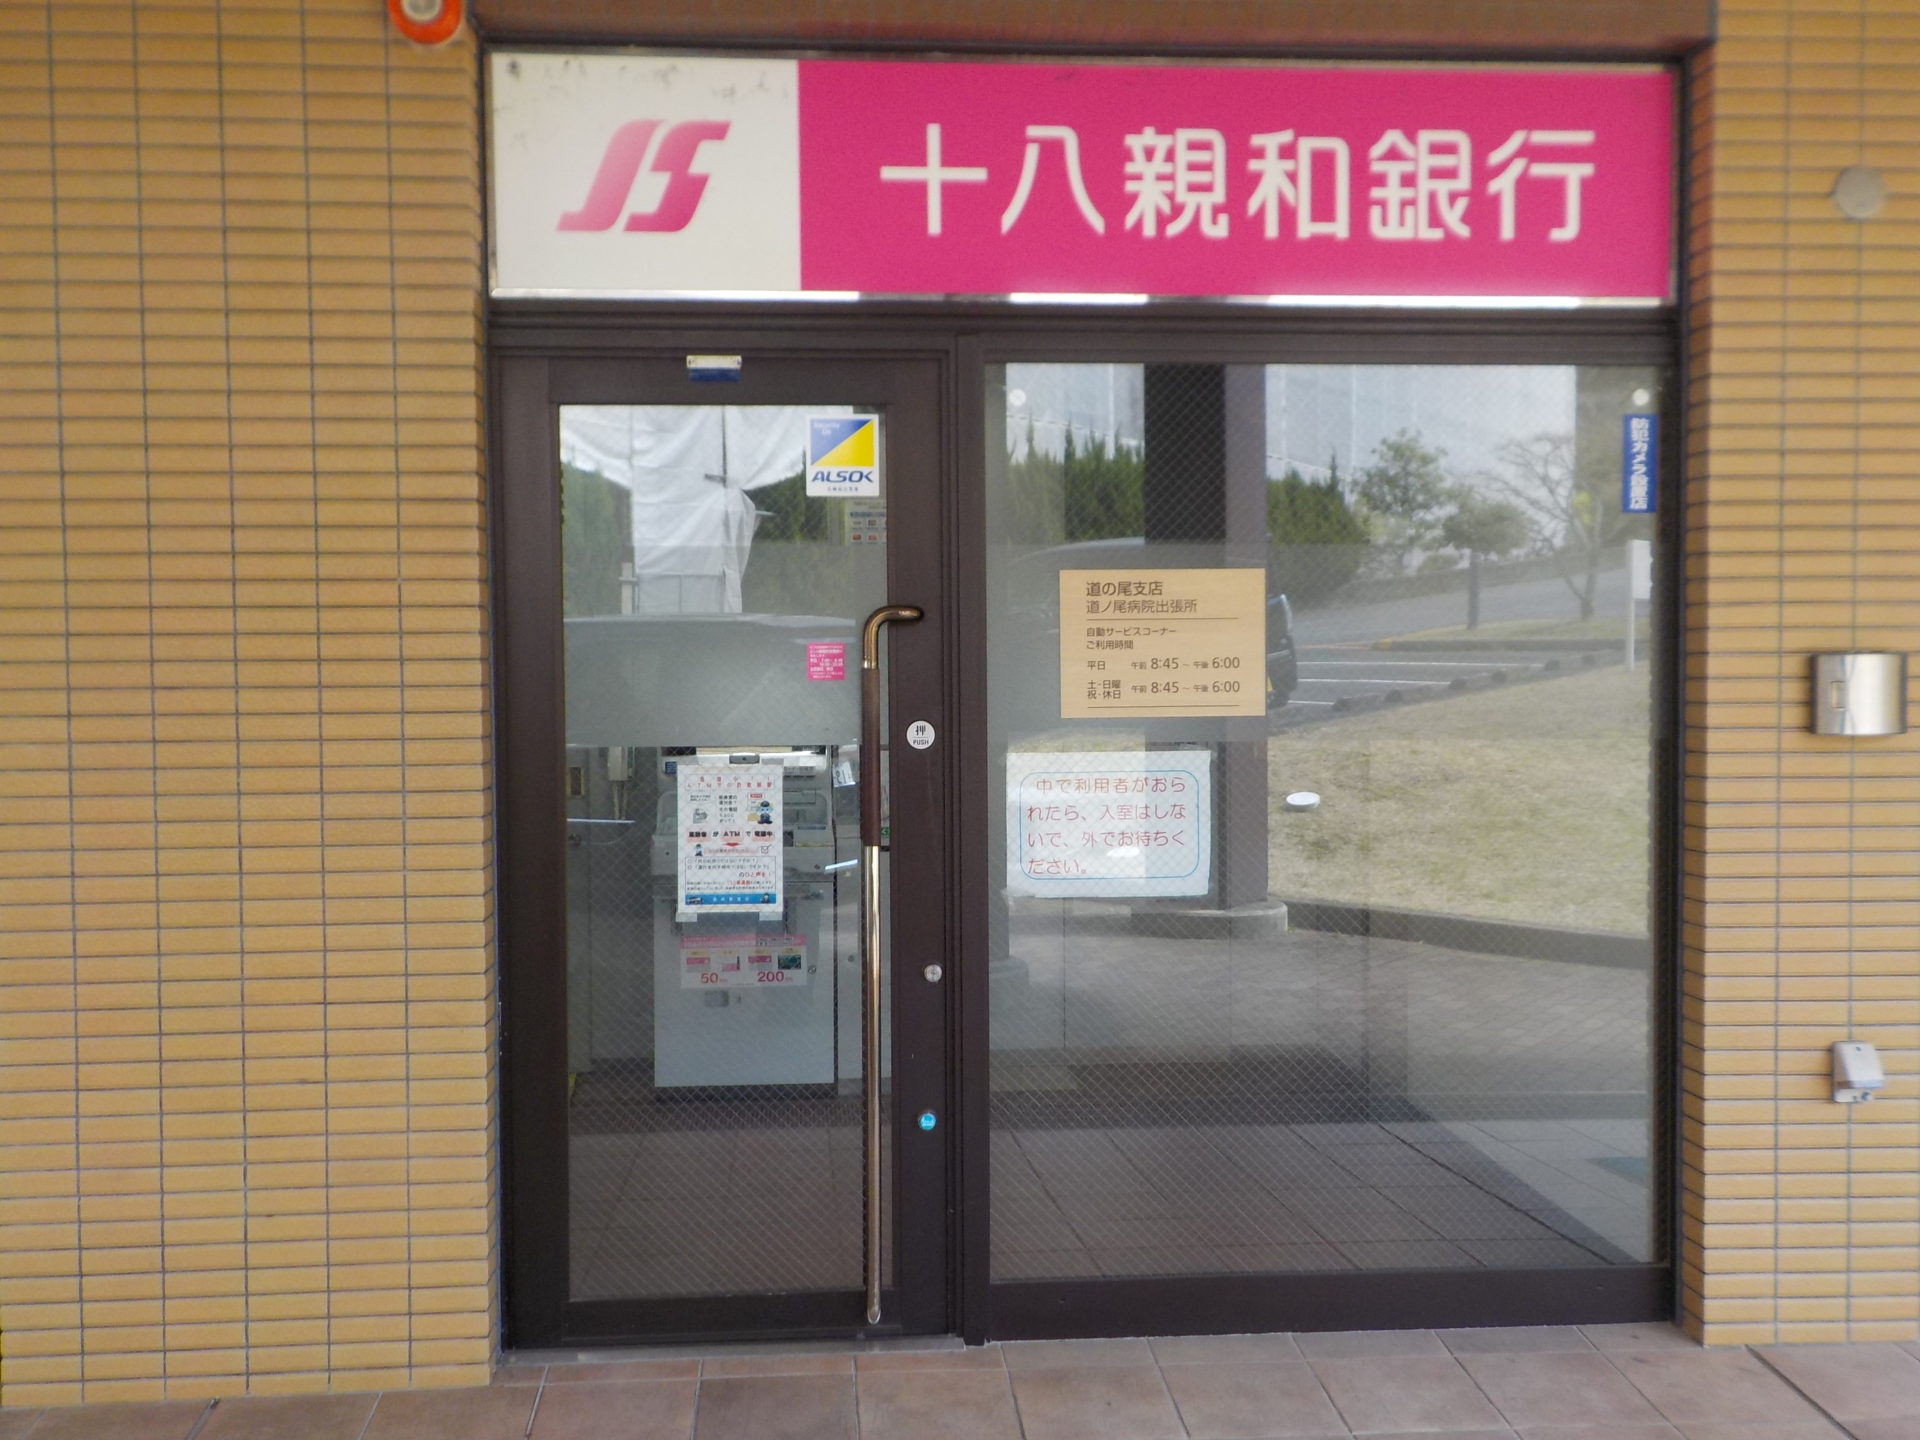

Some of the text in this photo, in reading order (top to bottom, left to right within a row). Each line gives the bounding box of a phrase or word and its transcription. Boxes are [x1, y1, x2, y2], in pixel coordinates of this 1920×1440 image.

[880, 122, 1597, 243] 十八親和銀行
[811, 470, 874, 483] ALSOK
[1086, 581, 1163, 596] 道の尾支店
[1086, 599, 1198, 614] 道ノ尾病院出張所
[1086, 627, 1177, 637] 自動サービスコーナー
[1086, 640, 1134, 650] ご利用時間
[1087, 661, 1106, 670] 平日
[1131, 662, 1147, 670] 午前
[1150, 658, 1179, 670] 8:45
[1212, 657, 1240, 669] 6:00
[1150, 682, 1179, 693] 8:45
[1212, 681, 1240, 692] 6:00
[915, 725, 926, 736] 押
[1036, 777, 1186, 794] 中で利用者がおら
[1027, 804, 1186, 821] れたら、入室はしな
[1027, 830, 1185, 848] いで、外でお待ちく
[1027, 858, 1087, 875] ださい。
[700, 972, 719, 984] 50
[757, 971, 785, 983] 200
